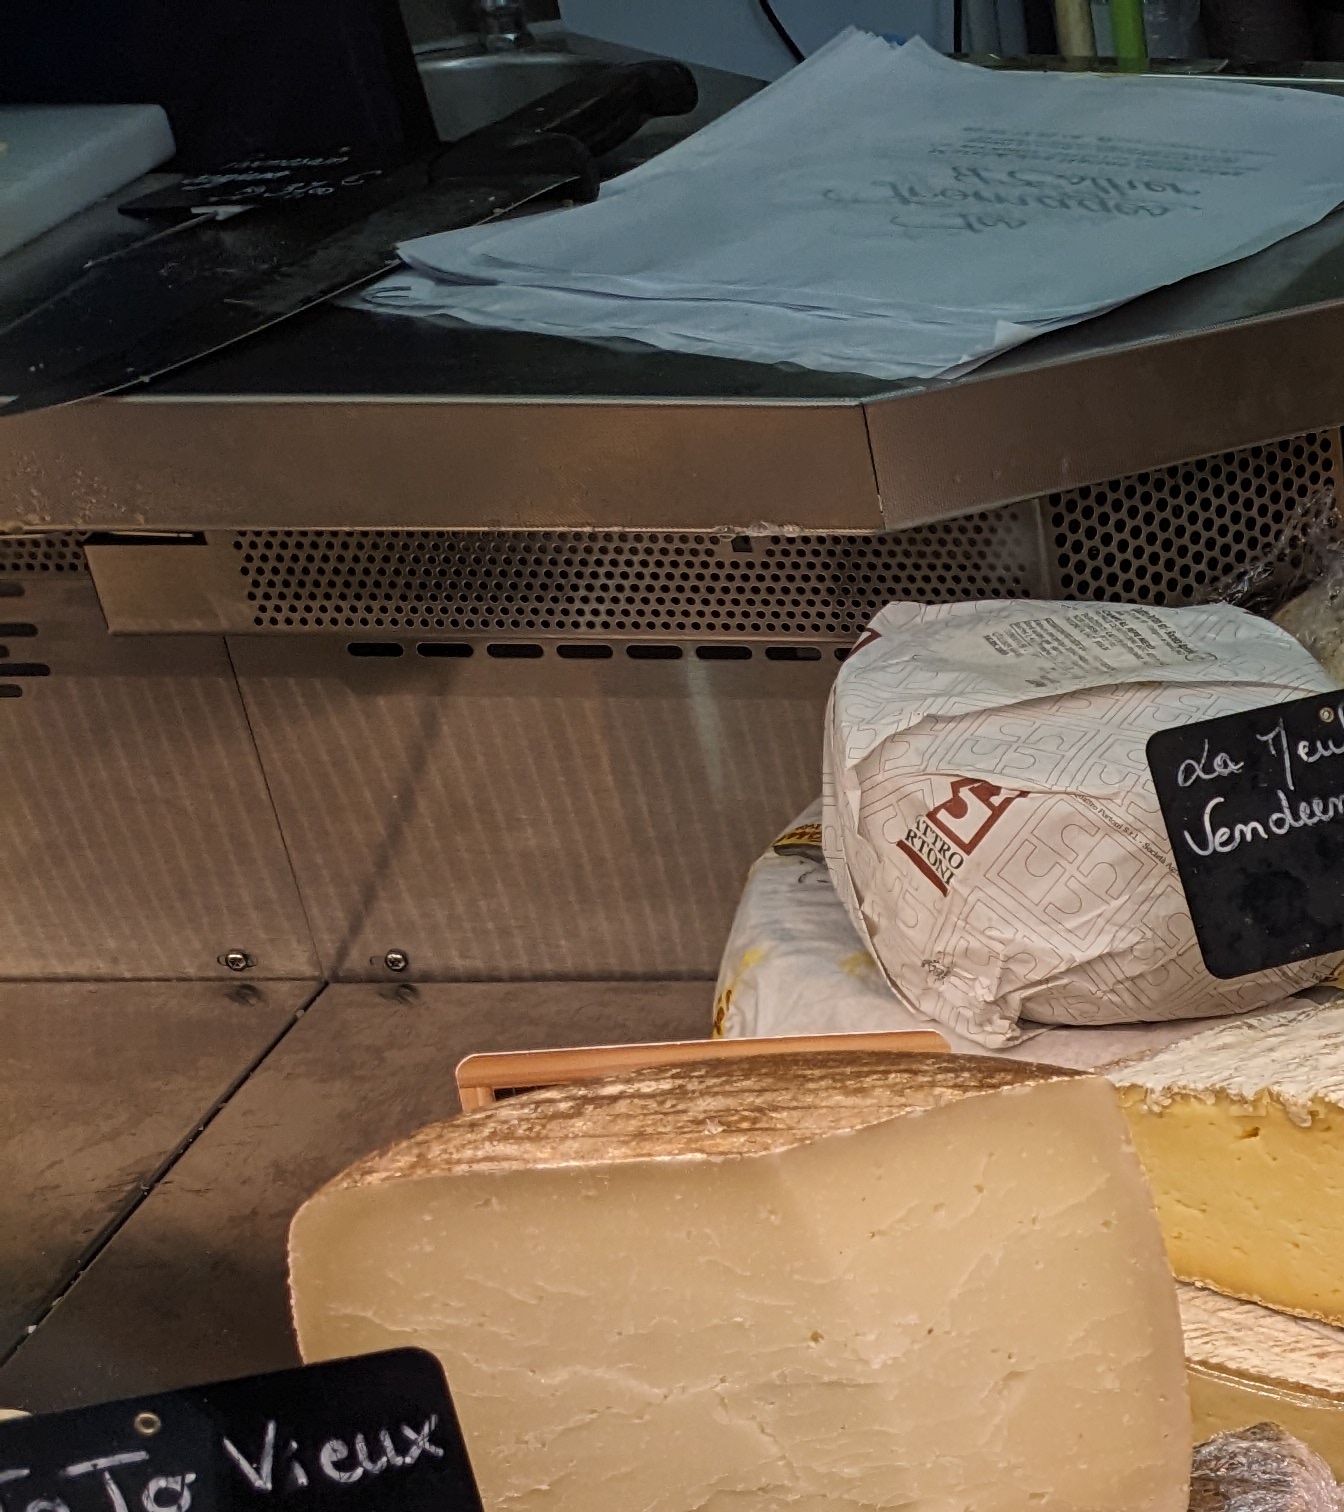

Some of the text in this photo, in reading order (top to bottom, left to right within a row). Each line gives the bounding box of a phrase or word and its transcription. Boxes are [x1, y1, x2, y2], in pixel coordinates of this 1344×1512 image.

[1177, 738, 1245, 788] La
[904, 828, 956, 887] RTONI
[222, 1413, 444, 1492] Vieux
